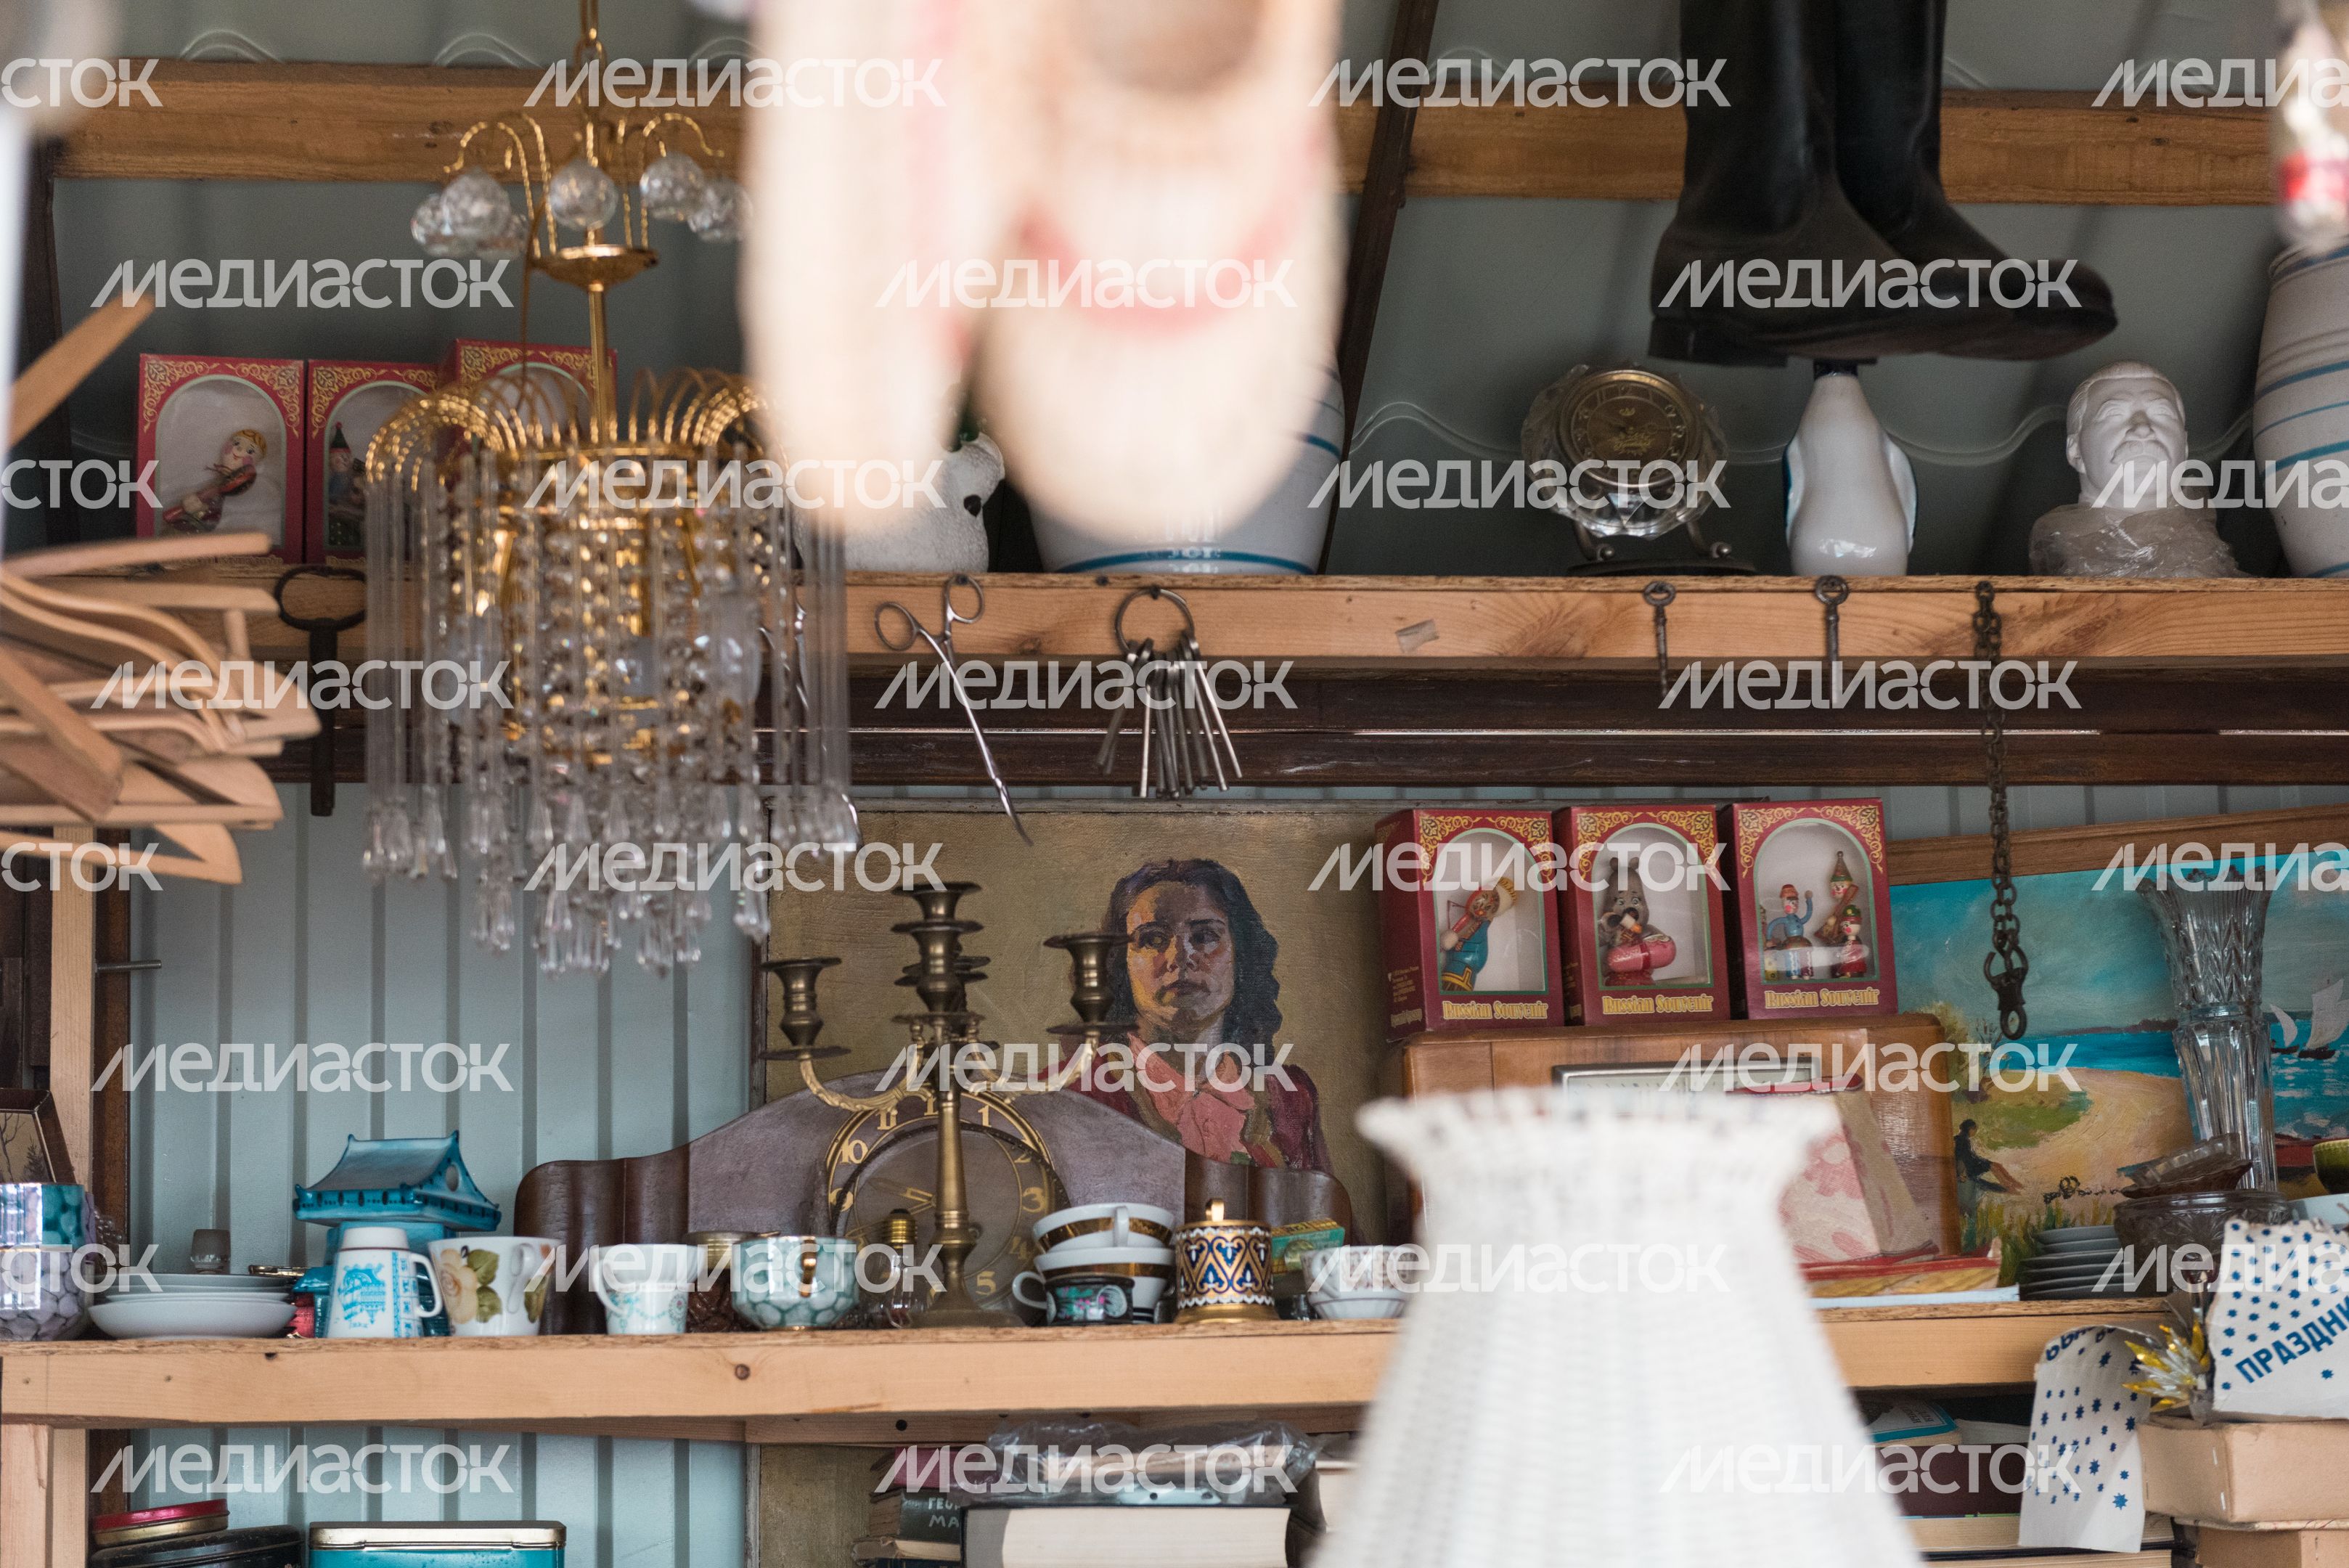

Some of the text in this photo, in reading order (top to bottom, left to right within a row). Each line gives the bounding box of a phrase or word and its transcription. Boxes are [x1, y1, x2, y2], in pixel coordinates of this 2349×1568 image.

[1442, 1001, 1493, 1019] Russian
[1493, 1000, 1548, 1019] Souvenir
[1601, 995, 1655, 1014] Russian
[1655, 993, 1714, 1013] Souvenir
[1764, 987, 1880, 1009] Russian Souvenir
[978, 1104, 992, 1127] 1
[838, 1138, 869, 1164] 10
[1021, 1186, 1044, 1213] 3
[976, 1270, 997, 1296] 5
